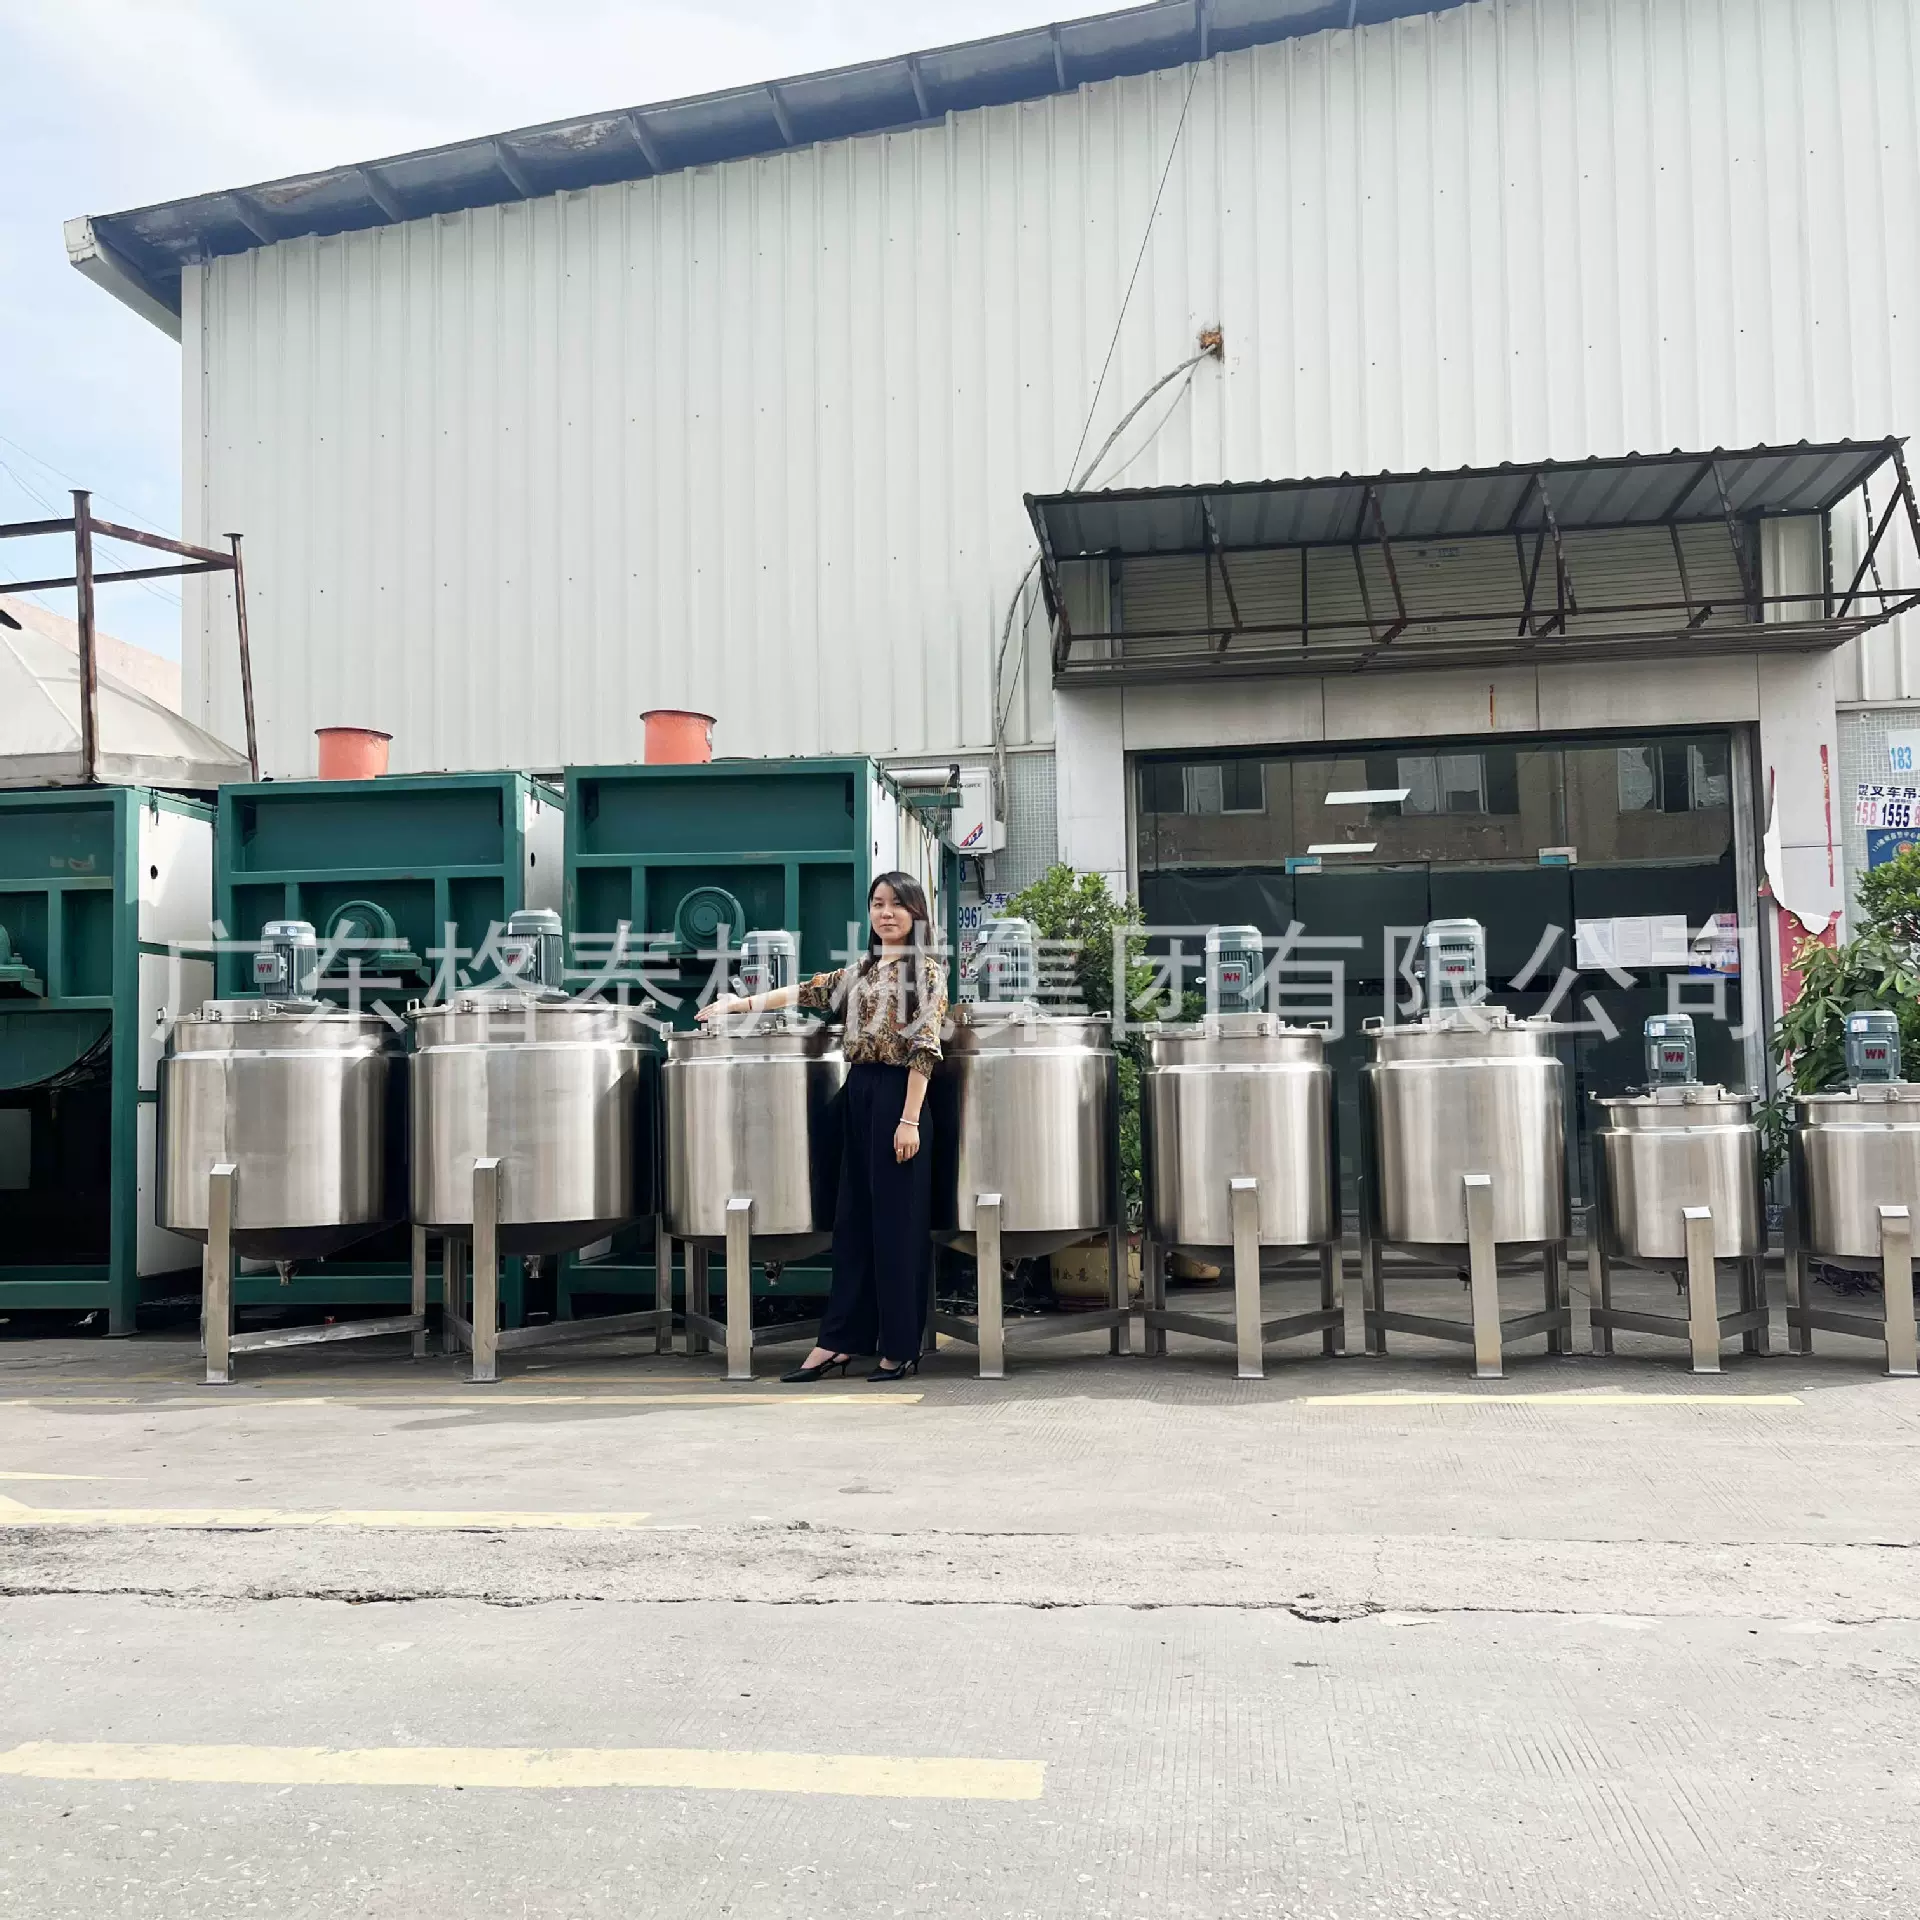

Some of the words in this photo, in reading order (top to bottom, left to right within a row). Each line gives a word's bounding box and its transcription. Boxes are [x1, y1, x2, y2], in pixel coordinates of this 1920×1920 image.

[1890, 746, 1912, 770] 183
[1870, 786, 1920, 799] 叉车吊
[1856, 802, 1877, 825] 158
[1881, 803, 1911, 828] 1555
[1664, 1051, 1684, 1062] WN
[1865, 1048, 1886, 1060] WN
